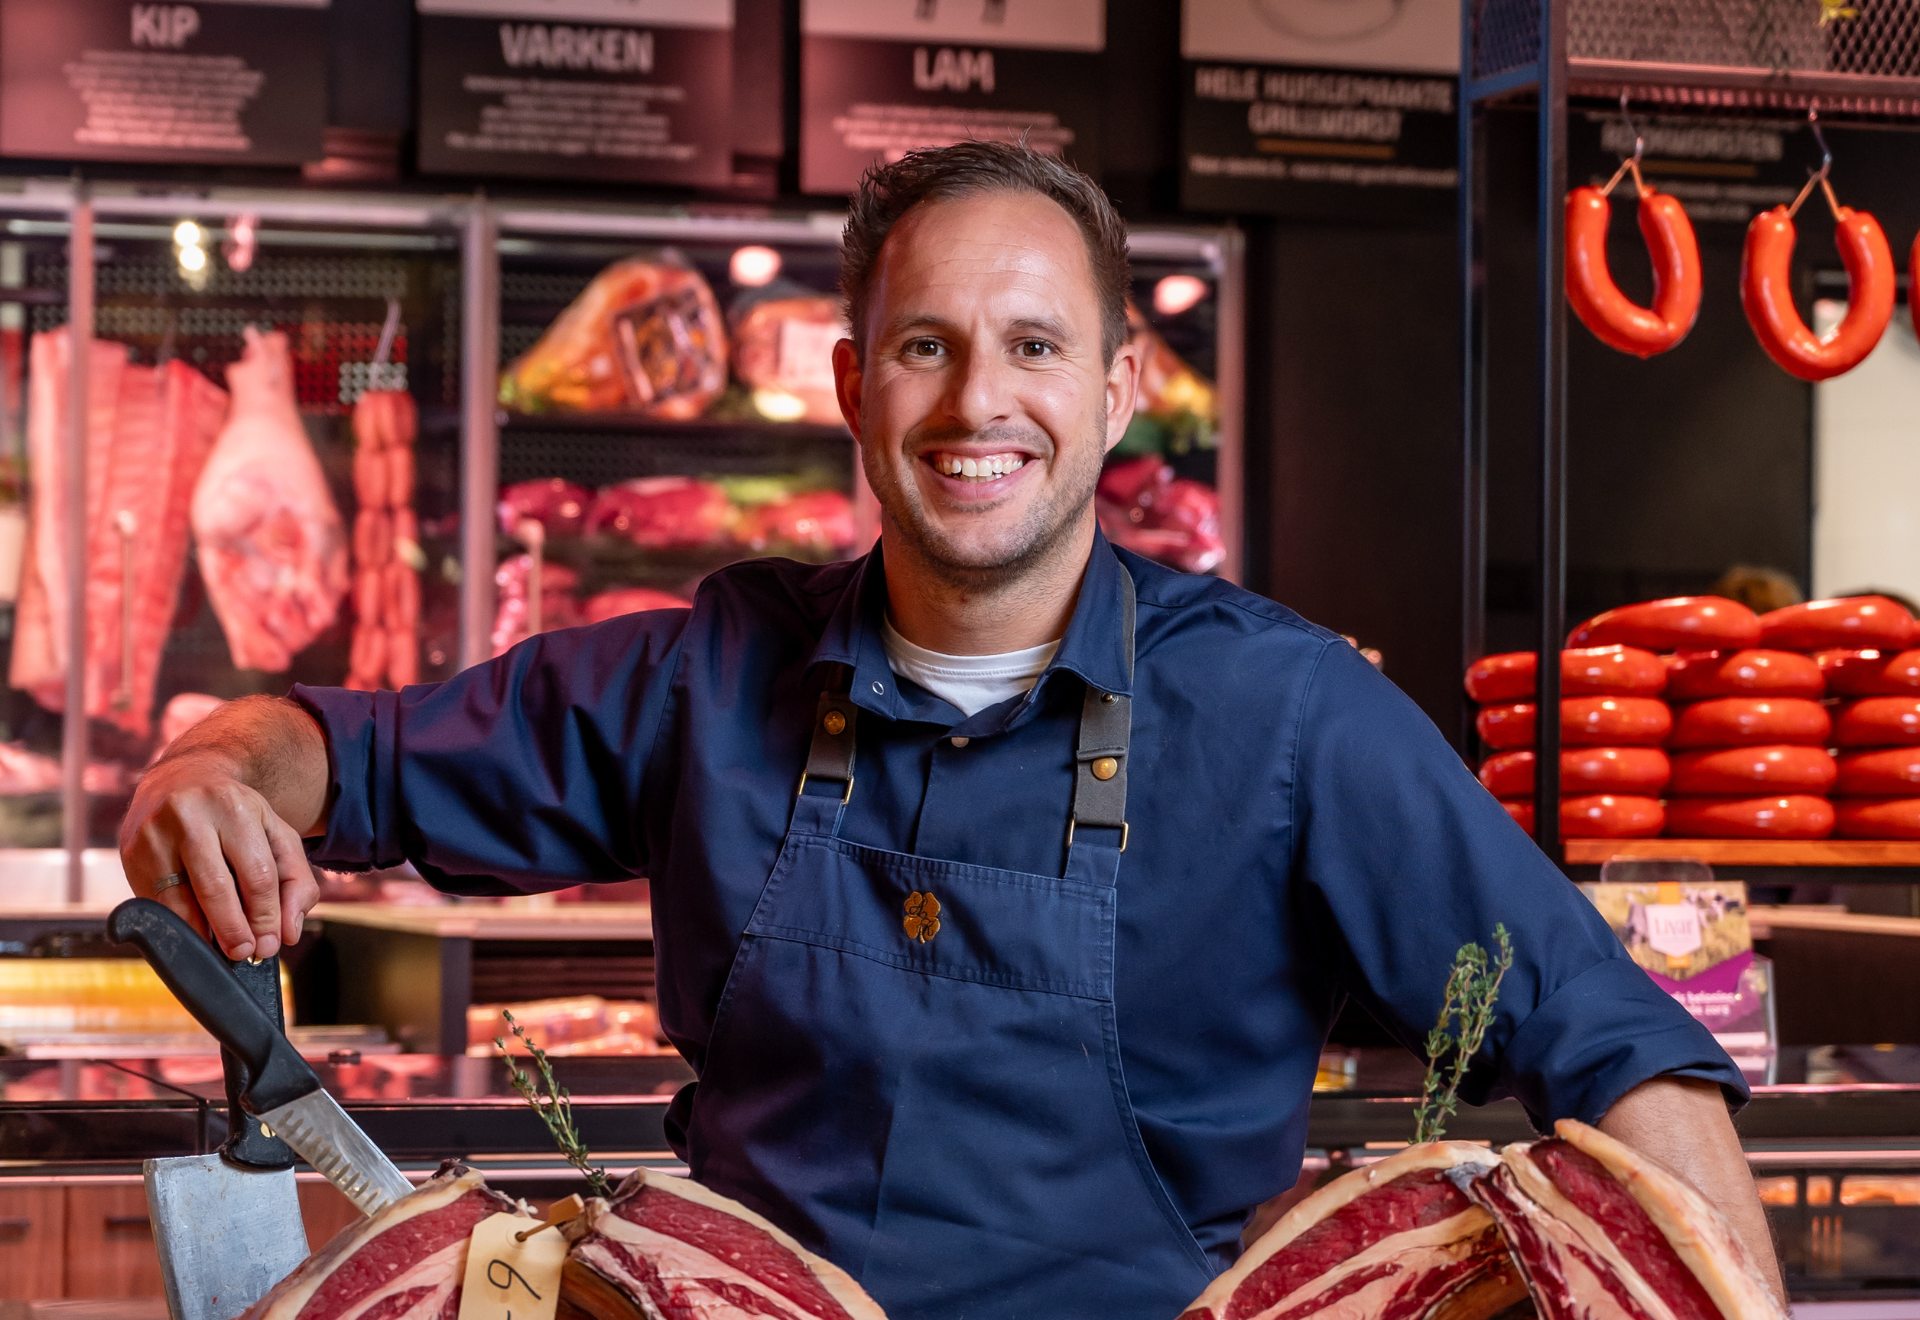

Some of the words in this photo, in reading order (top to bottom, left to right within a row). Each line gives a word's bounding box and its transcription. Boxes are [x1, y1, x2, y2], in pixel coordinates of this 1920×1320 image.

[131, 4, 200, 47] KIP
[500, 23, 654, 73] VARKEN
[914, 48, 995, 92] LAM
